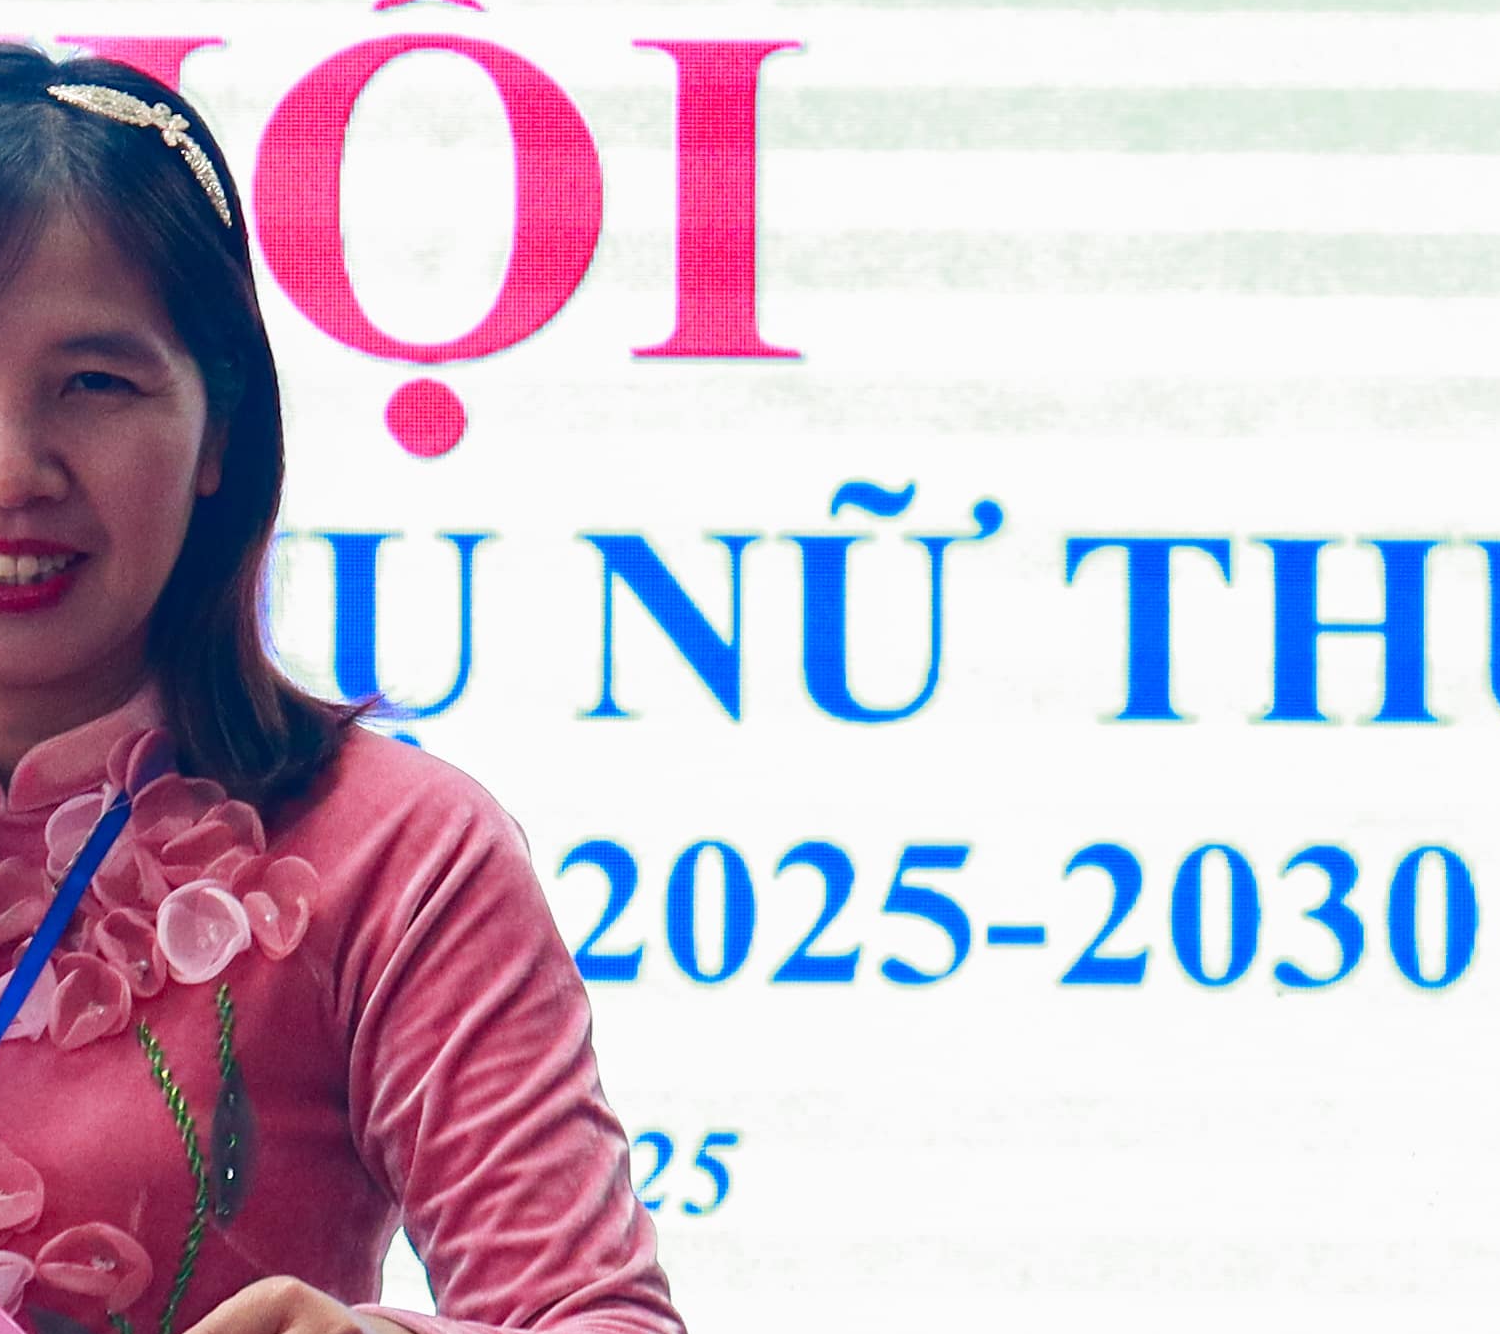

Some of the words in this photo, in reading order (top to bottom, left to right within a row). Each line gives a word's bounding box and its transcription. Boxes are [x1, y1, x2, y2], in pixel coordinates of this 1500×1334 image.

[580, 481, 1007, 729] NỮ
[558, 839, 1482, 991] 2025-2030
[632, 1131, 741, 1216] 25
